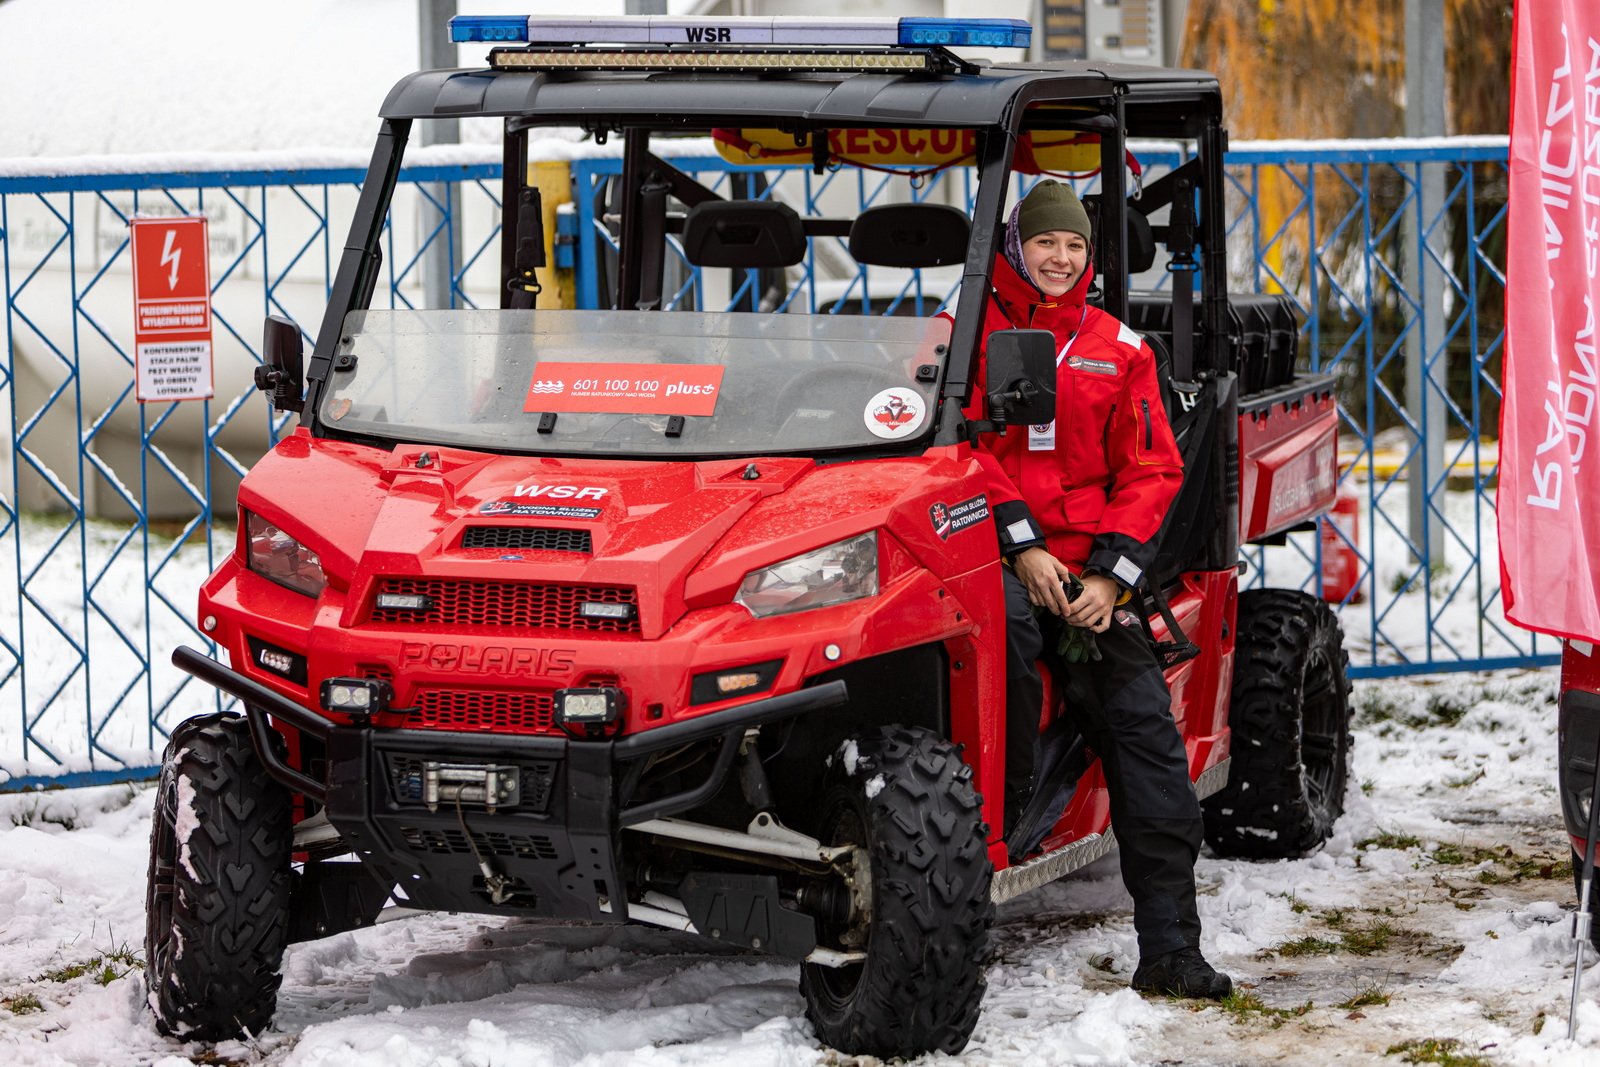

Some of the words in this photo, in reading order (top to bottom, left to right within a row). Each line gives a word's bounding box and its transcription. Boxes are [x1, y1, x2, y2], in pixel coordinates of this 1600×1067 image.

[685, 27, 731, 43] WSR
[144, 346, 205, 355] KONTENEROWEJ
[176, 356, 199, 364] PALIW
[157, 387, 194, 395] LOTNISKA
[573, 379, 599, 390] 601
[604, 379, 630, 391] 100
[634, 380, 659, 392] 100
[513, 485, 609, 500] WSR
[511, 509, 595, 518] RATOWNICZA
[949, 505, 970, 518] WODNA
[951, 507, 989, 529] RATOWNICZA
[399, 642, 577, 678] POLARIS
